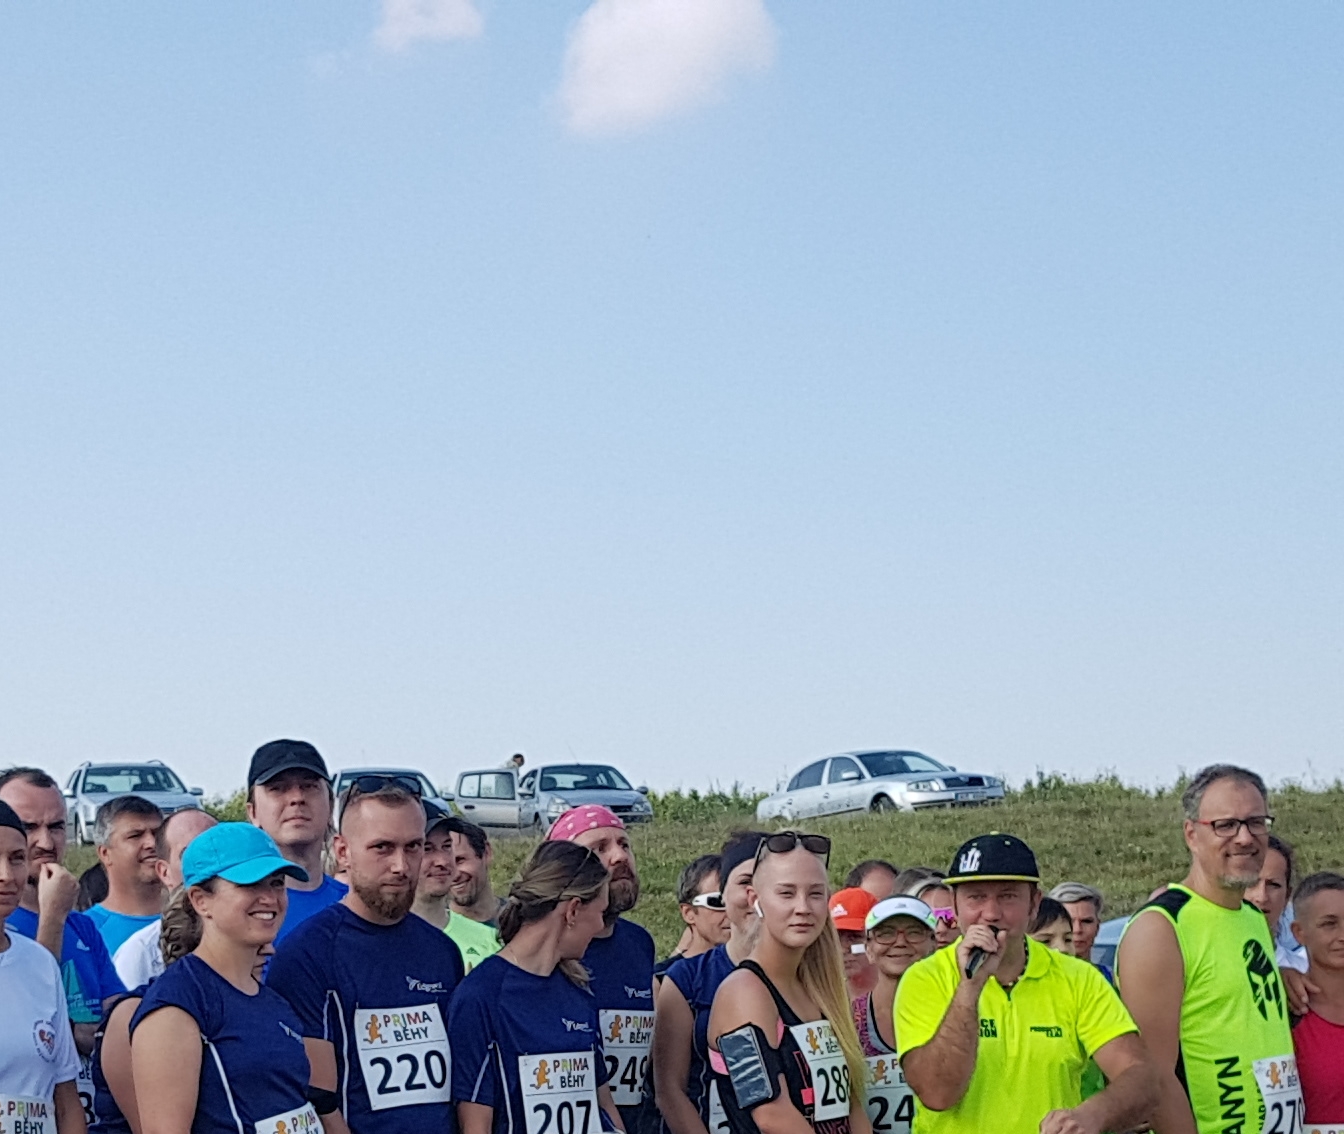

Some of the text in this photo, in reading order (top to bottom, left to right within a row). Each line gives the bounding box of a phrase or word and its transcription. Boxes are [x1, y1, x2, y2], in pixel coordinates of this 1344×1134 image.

[383, 1011, 433, 1028] PRIMA
[393, 1026, 429, 1042] BĚHY
[369, 1049, 447, 1095] 220
[552, 1057, 590, 1073] PRIMA
[560, 1071, 586, 1089] BĚHY
[7, 1100, 48, 1119] PRIMA
[868, 1094, 914, 1131] 24
[290, 1109, 316, 1133] PRIM
